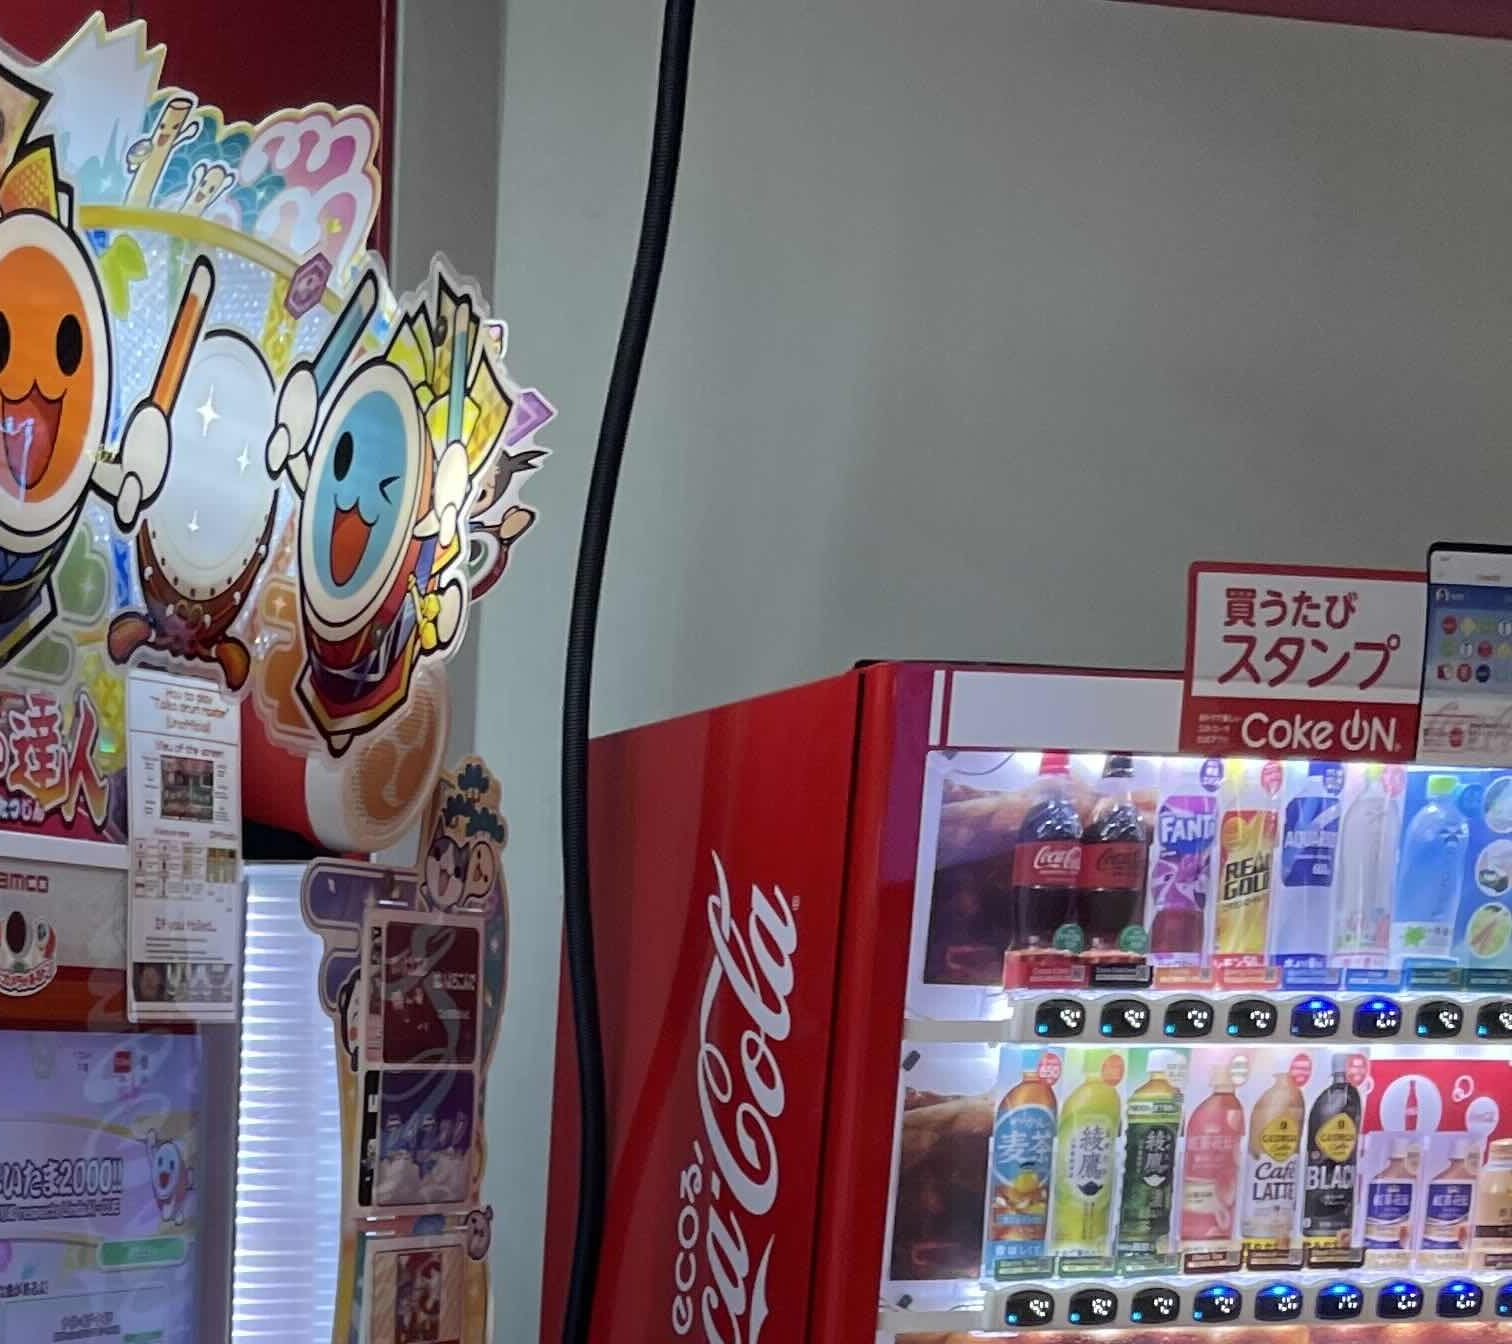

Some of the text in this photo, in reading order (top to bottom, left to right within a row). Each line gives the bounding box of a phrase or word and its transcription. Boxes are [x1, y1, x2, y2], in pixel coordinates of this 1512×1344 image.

[1224, 588, 1358, 629] 買うたび
[1217, 632, 1402, 690] スタンプ
[1241, 711, 1334, 750] Coke
[1340, 708, 1397, 752] ON
[1159, 815, 1215, 846] FANT
